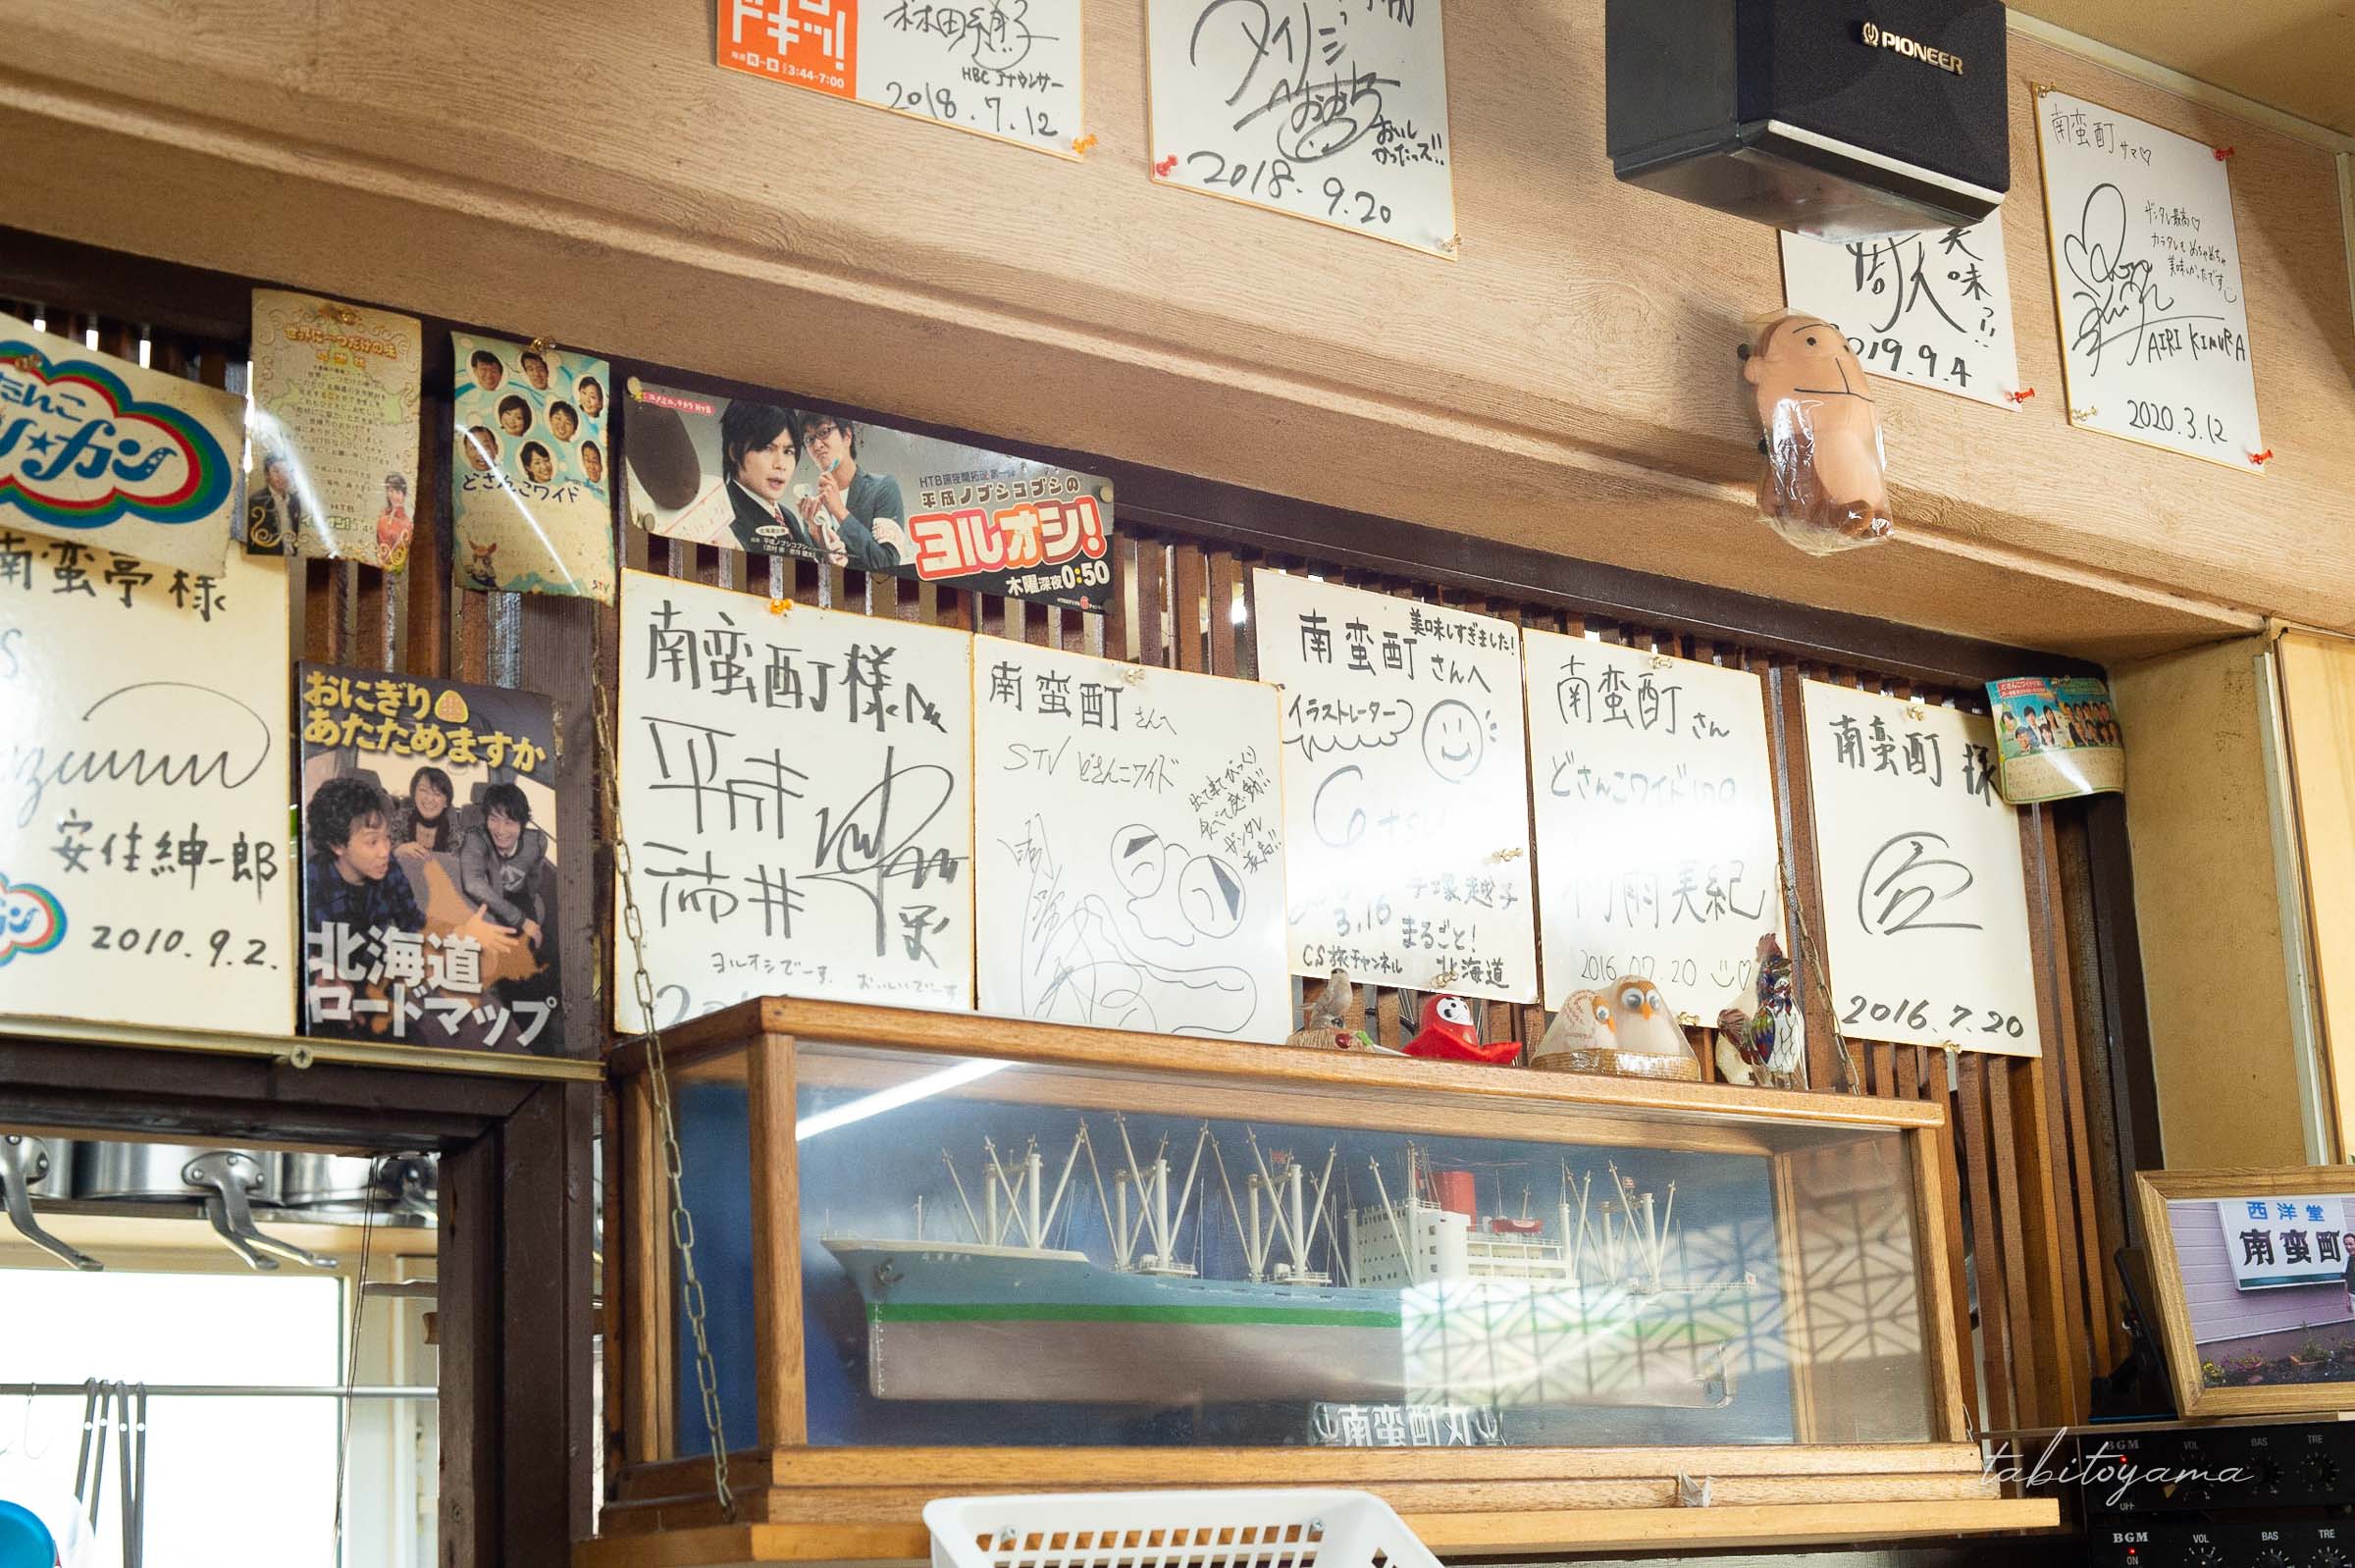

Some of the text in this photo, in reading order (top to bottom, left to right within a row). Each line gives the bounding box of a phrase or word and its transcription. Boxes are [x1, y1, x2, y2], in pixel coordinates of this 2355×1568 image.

[1881, 30, 1963, 76] PIONEER
[963, 67, 989, 85] HBC
[886, 81, 1058, 136] 2018.7.12
[1186, 150, 1392, 224] 2018.9.20
[1835, 325, 1972, 388] 019.9.4
[2147, 323, 2246, 363] AIRI KIMURA
[2126, 399, 2227, 444] 2020.3.12
[462, 472, 580, 503] どさんこワイド
[920, 477, 1080, 509] 平成ノブシコブシの
[1006, 560, 1111, 597] 木曜深夜0:50
[1408, 607, 1515, 655] 美味しすぎました!
[1299, 607, 1492, 694] 南蛮酊さんへ
[302, 670, 432, 719] おにぎり
[1288, 694, 1397, 733] イラストレーター
[1556, 654, 1730, 739] 南蛮酊さん
[304, 708, 546, 773] あたためますか
[1004, 736, 1179, 793] STV どさんこワイド
[1402, 915, 1477, 953] まるごと!
[307, 920, 483, 994] 北海道
[1436, 954, 1510, 989] 北海道
[308, 984, 557, 1047] ロードマップ
[1842, 994, 2025, 1038] 2016.7.20
[2246, 1200, 2326, 1223] 西洋堂
[2239, 1228, 2342, 1266] 南蛮酊
[2183, 1440, 2199, 1450] VOL
[2251, 1437, 2269, 1447] BAS
[2308, 1435, 2324, 1444] TRE
[2113, 1532, 2149, 1543] BGM
[2192, 1534, 2209, 1543] VOL
[2262, 1531, 2278, 1541] BAS
[2319, 1529, 2335, 1540] TRE
[2126, 1556, 2139, 1566] ON
